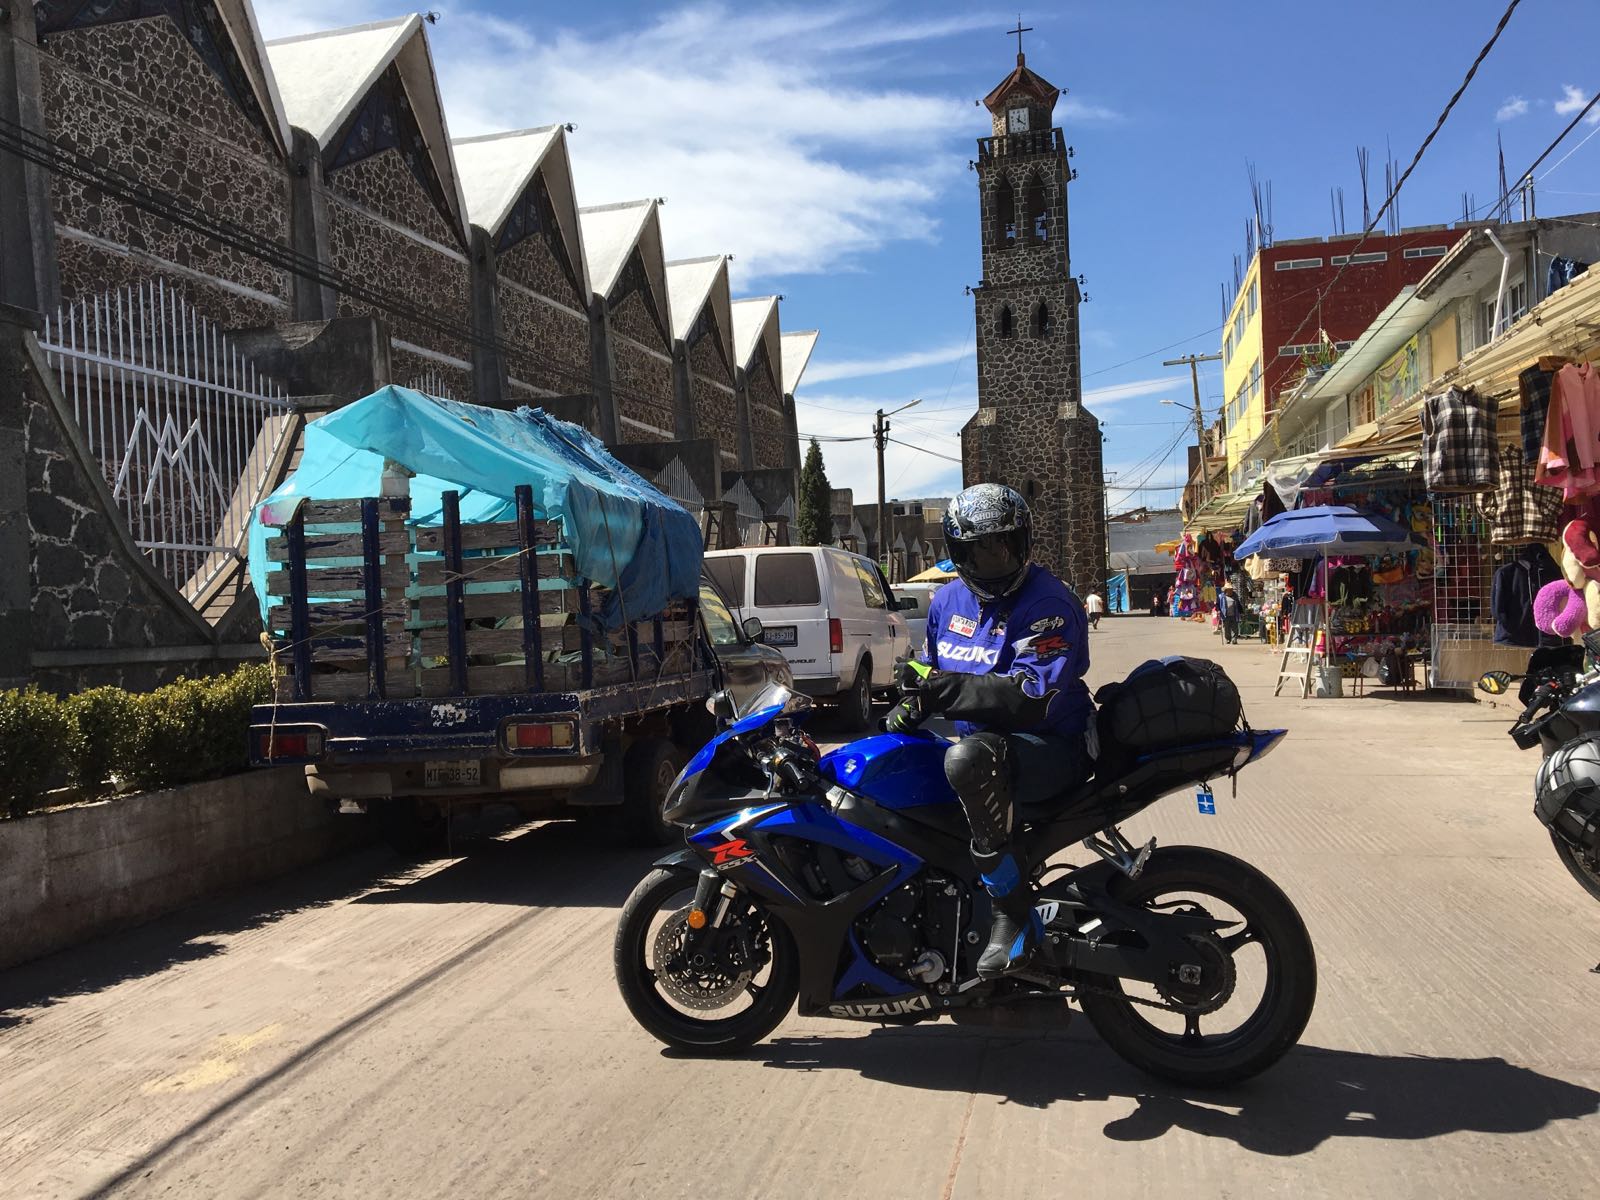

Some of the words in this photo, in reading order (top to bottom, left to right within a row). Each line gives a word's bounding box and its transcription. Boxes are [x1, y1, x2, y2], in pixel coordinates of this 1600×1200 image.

[974, 511, 999, 521] SHOEI
[937, 641, 999, 665] SUZUKI
[828, 995, 932, 1018] SUZUKI
